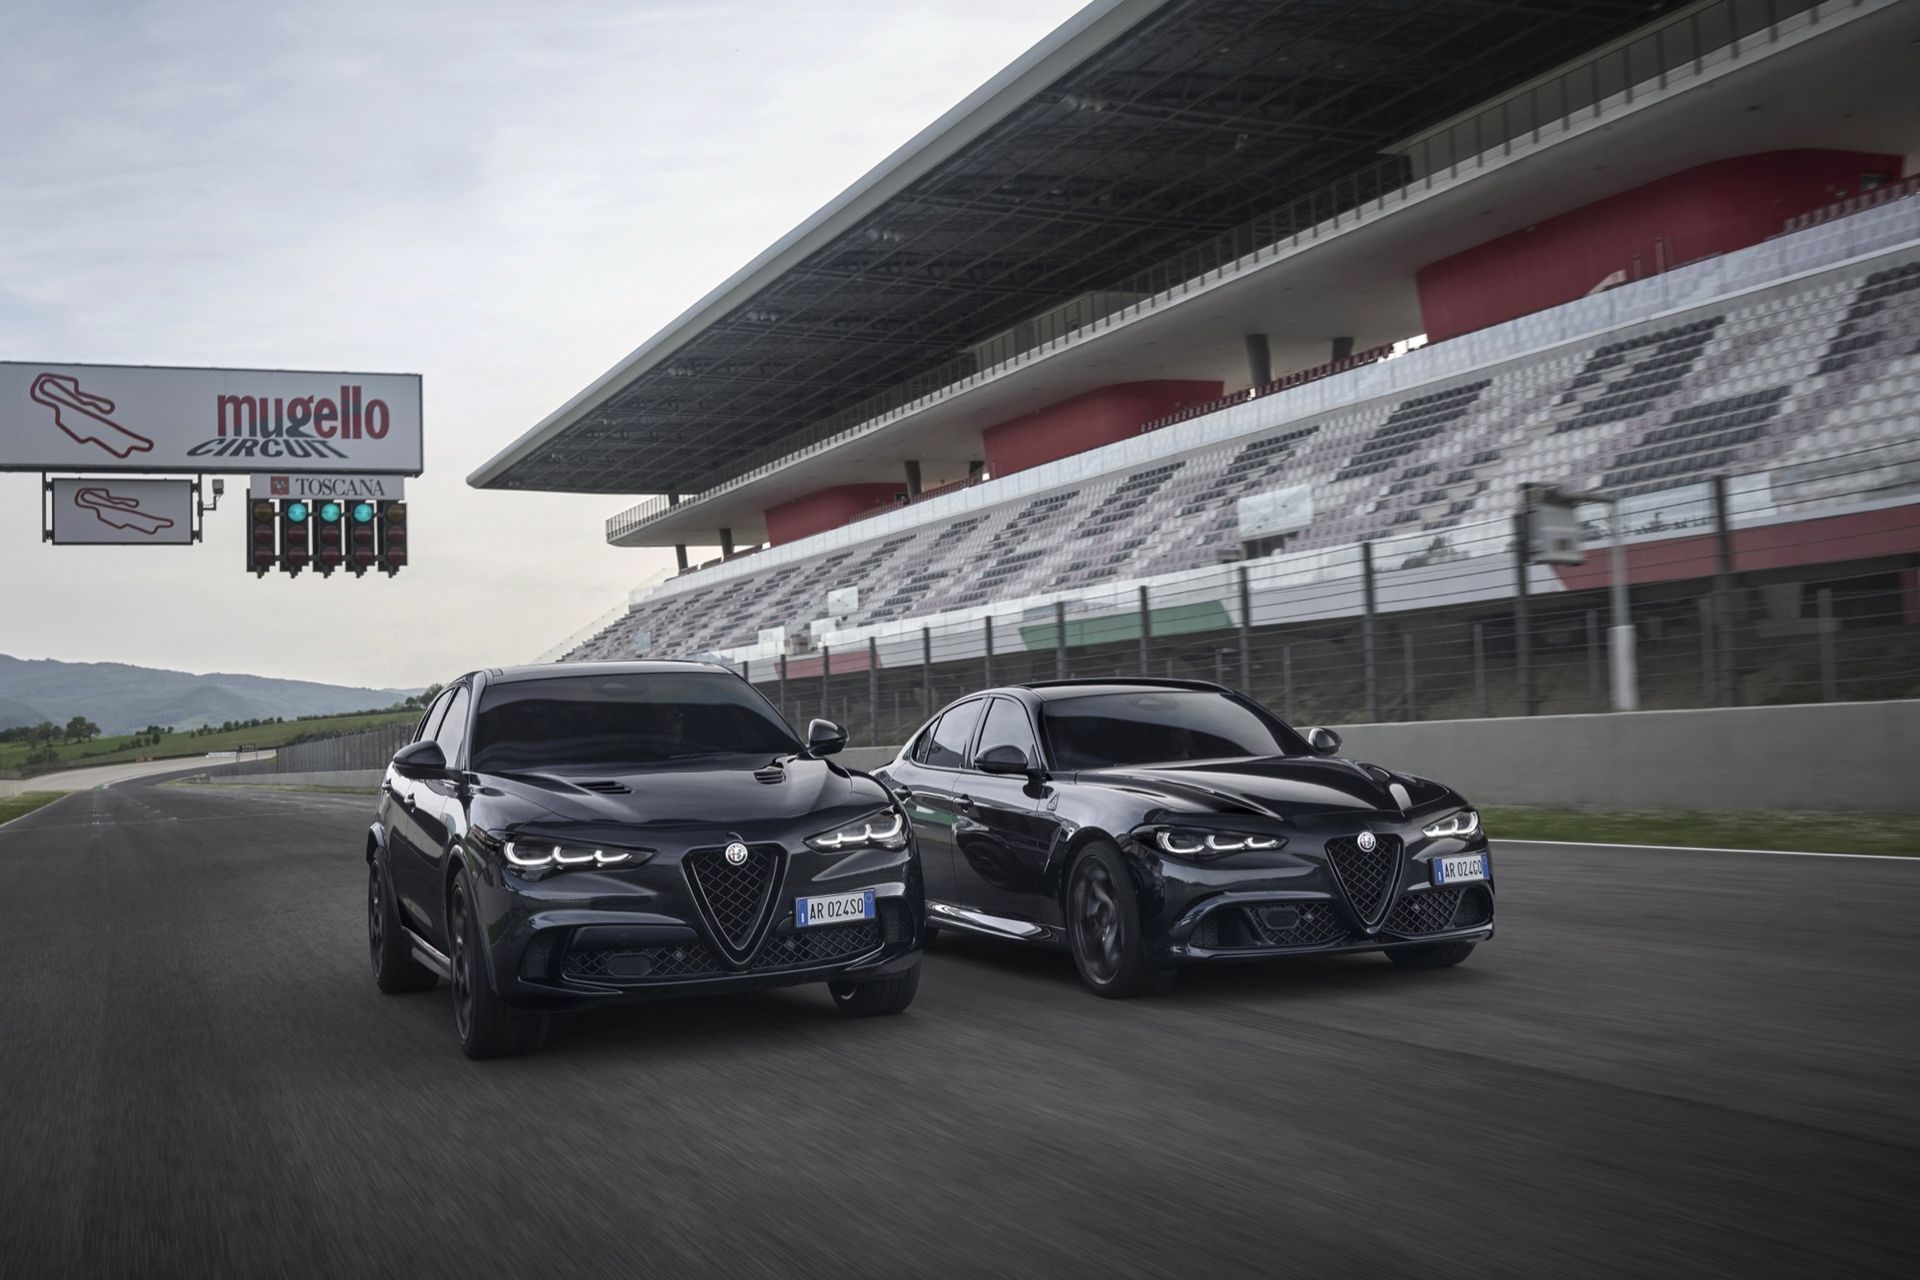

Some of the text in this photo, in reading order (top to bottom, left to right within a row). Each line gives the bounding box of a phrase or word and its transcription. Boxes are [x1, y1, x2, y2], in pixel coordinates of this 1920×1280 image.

[217, 385, 390, 440] mugello
[186, 438, 350, 459] CIRCUIT
[295, 479, 385, 496] TOSCANA
[1445, 862, 1456, 878] AR
[809, 902, 824, 920] AR
